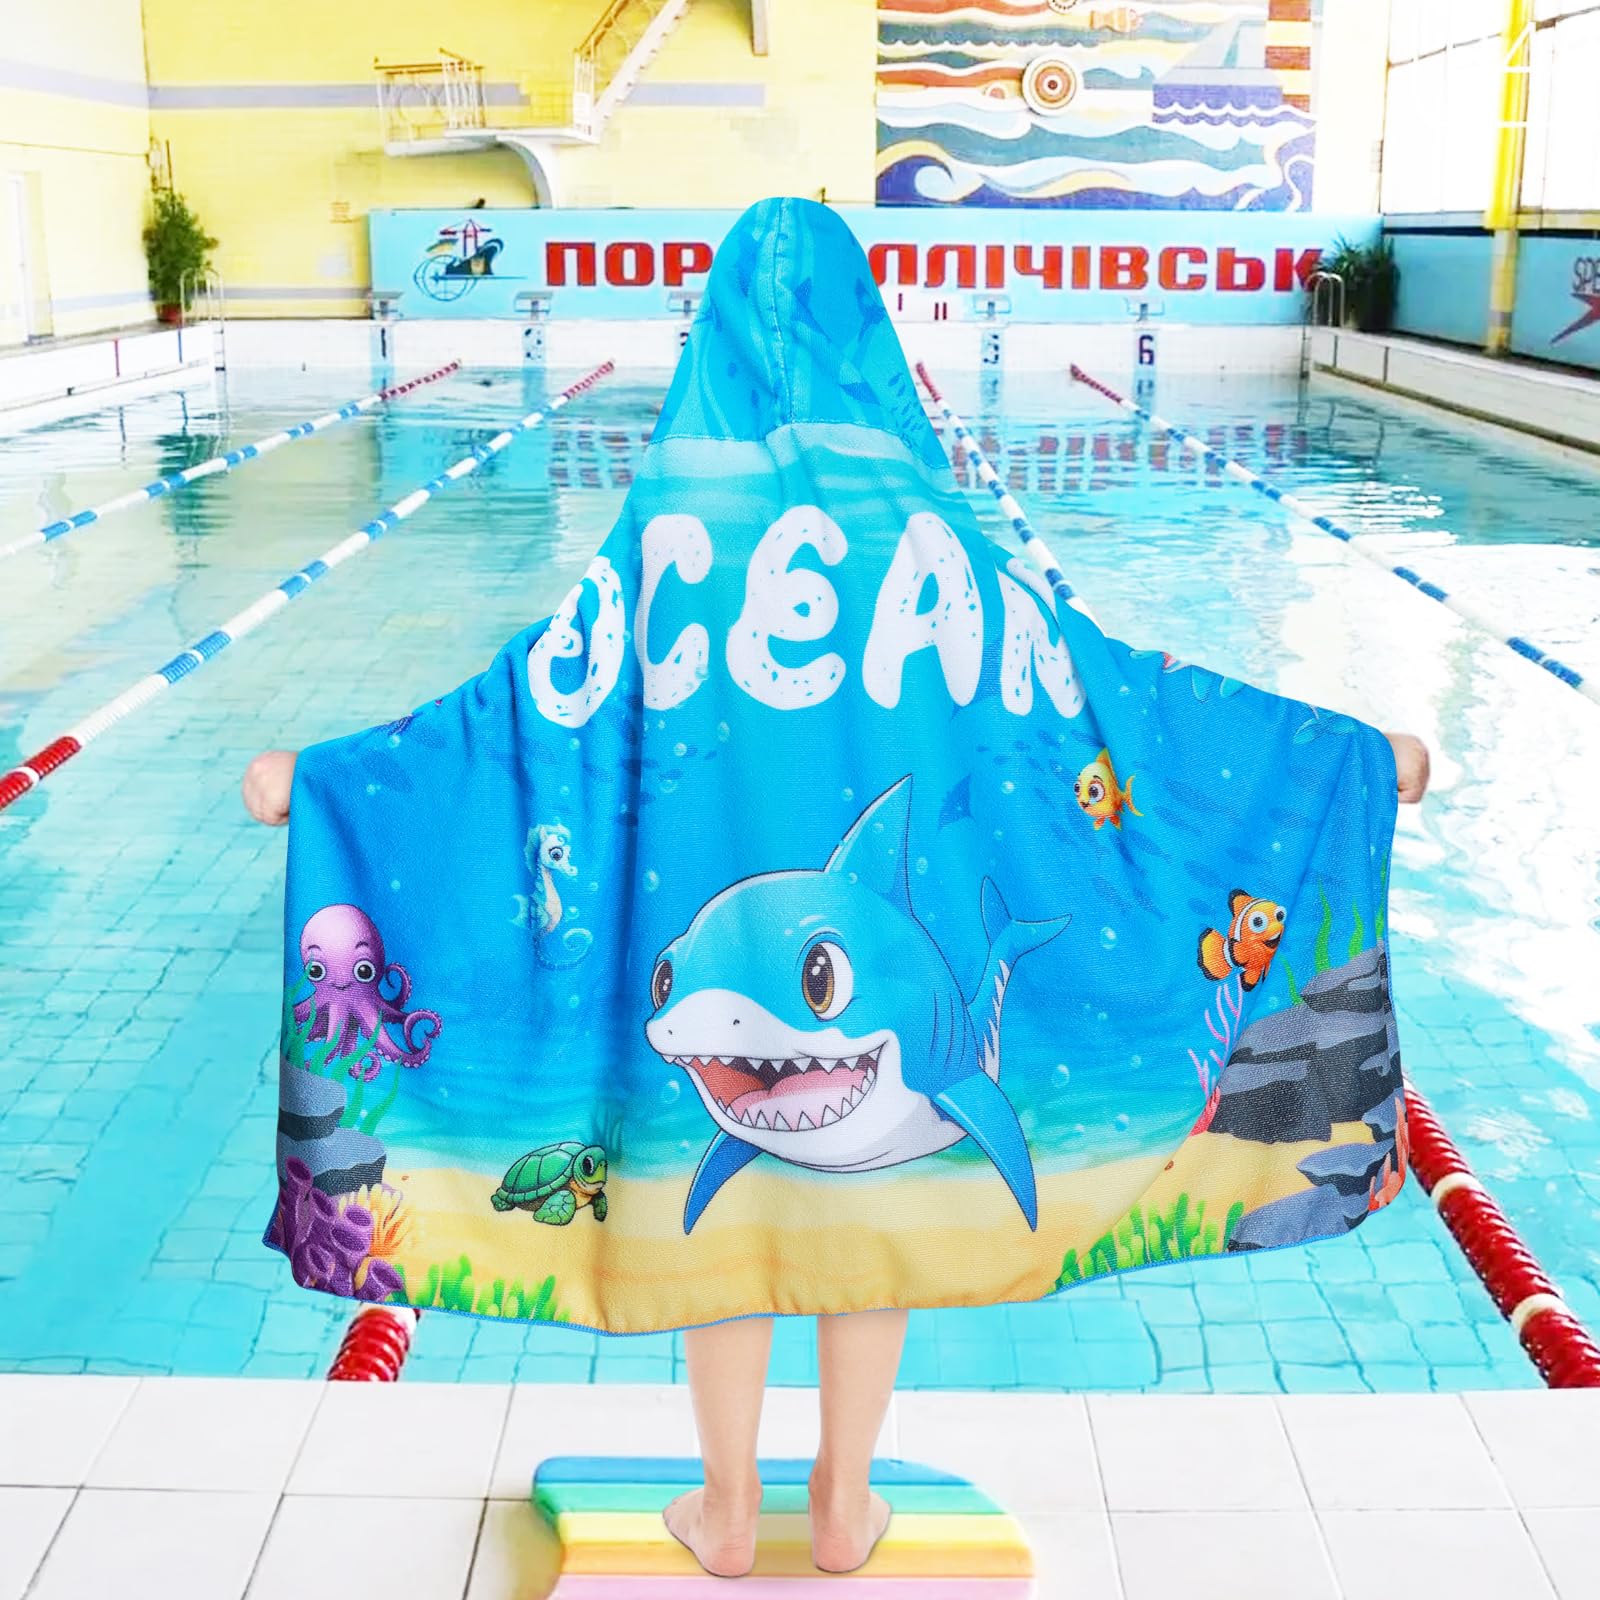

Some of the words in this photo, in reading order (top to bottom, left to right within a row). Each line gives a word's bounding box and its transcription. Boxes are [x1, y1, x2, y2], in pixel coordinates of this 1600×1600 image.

[545, 241, 714, 287] ПОР
[868, 243, 1324, 293] ЛЛІЧІВСЬК
[1138, 334, 1154, 366] 6
[527, 504, 1085, 728] OCEAN
